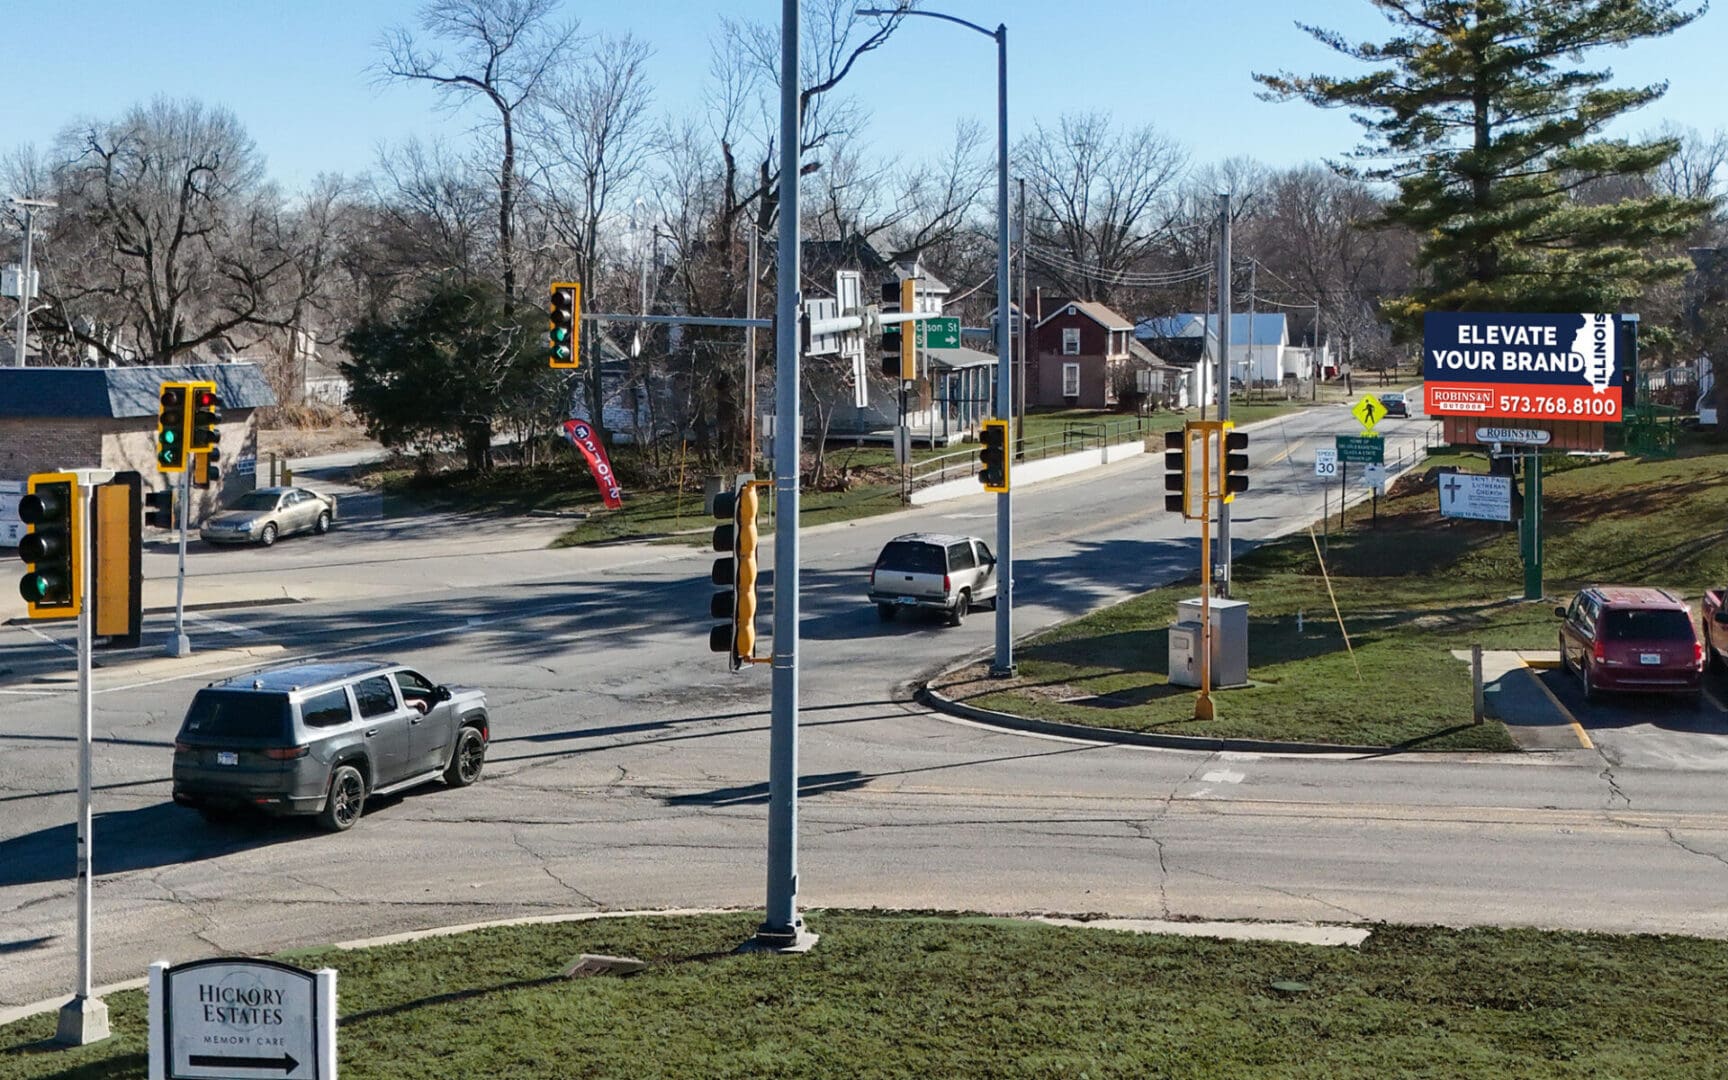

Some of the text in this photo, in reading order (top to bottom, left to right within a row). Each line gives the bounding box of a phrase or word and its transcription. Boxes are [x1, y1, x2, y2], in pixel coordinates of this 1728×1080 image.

[947, 322, 957, 332] St
[1458, 325, 1558, 346] ELEVATE
[1594, 312, 1606, 385] ILLINOIS
[1432, 350, 1585, 373] YOUR BRAND
[1500, 395, 1616, 416] 573.768.8100
[1318, 462, 1335, 473] 30
[199, 984, 286, 1006] HICKORY
[204, 1004, 283, 1025] ESTATES
[203, 1035, 285, 1047] MEMORY CARE
